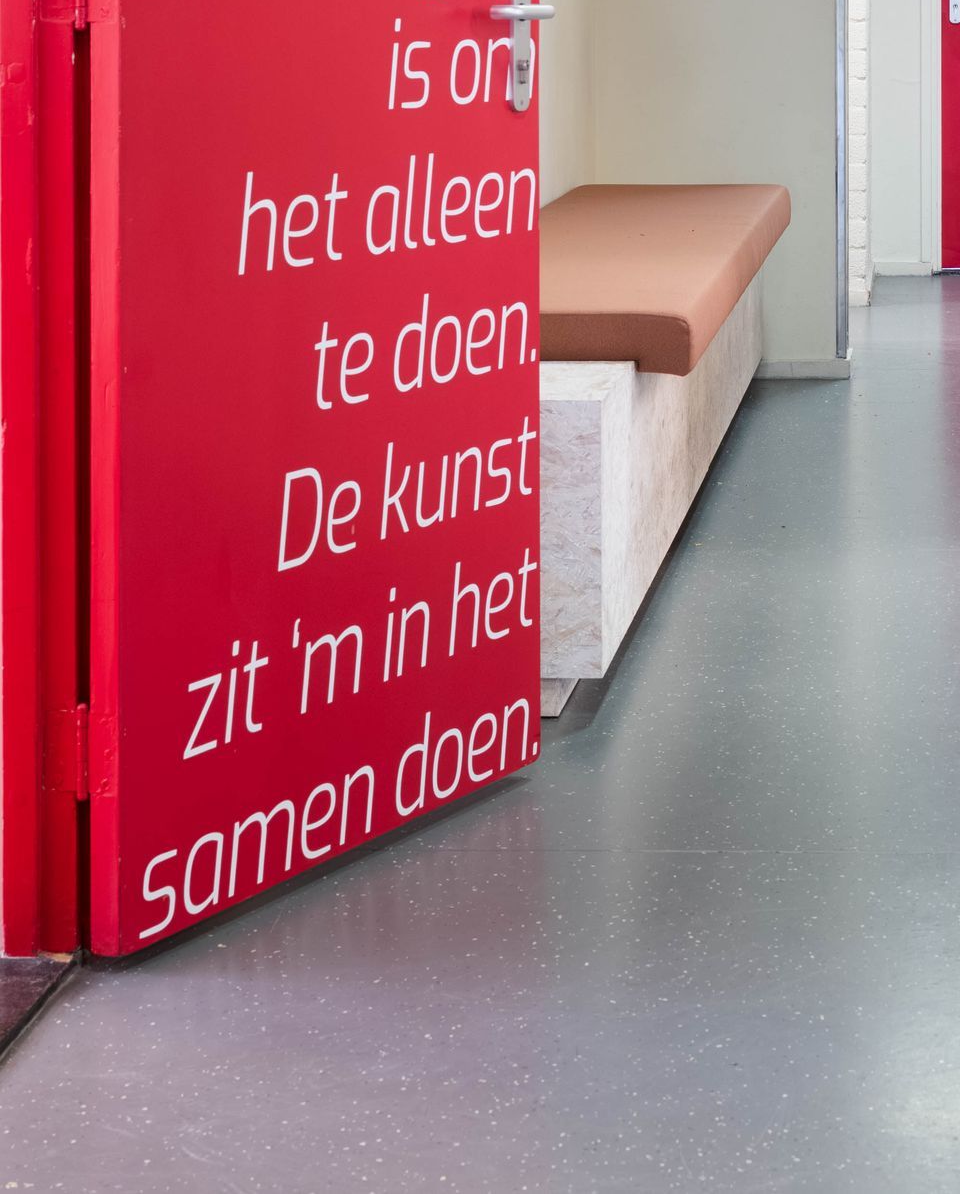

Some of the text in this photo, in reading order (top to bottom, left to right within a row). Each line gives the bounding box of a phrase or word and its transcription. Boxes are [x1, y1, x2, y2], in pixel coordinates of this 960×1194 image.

[388, 17, 537, 110] is om
[238, 152, 537, 276] het alleen
[314, 293, 537, 410] te doen.
[277, 416, 537, 572] De kunst
[182, 640, 269, 760] zit
[383, 587, 430, 682] in
[448, 548, 538, 657] het
[138, 697, 539, 940] samen doen.
